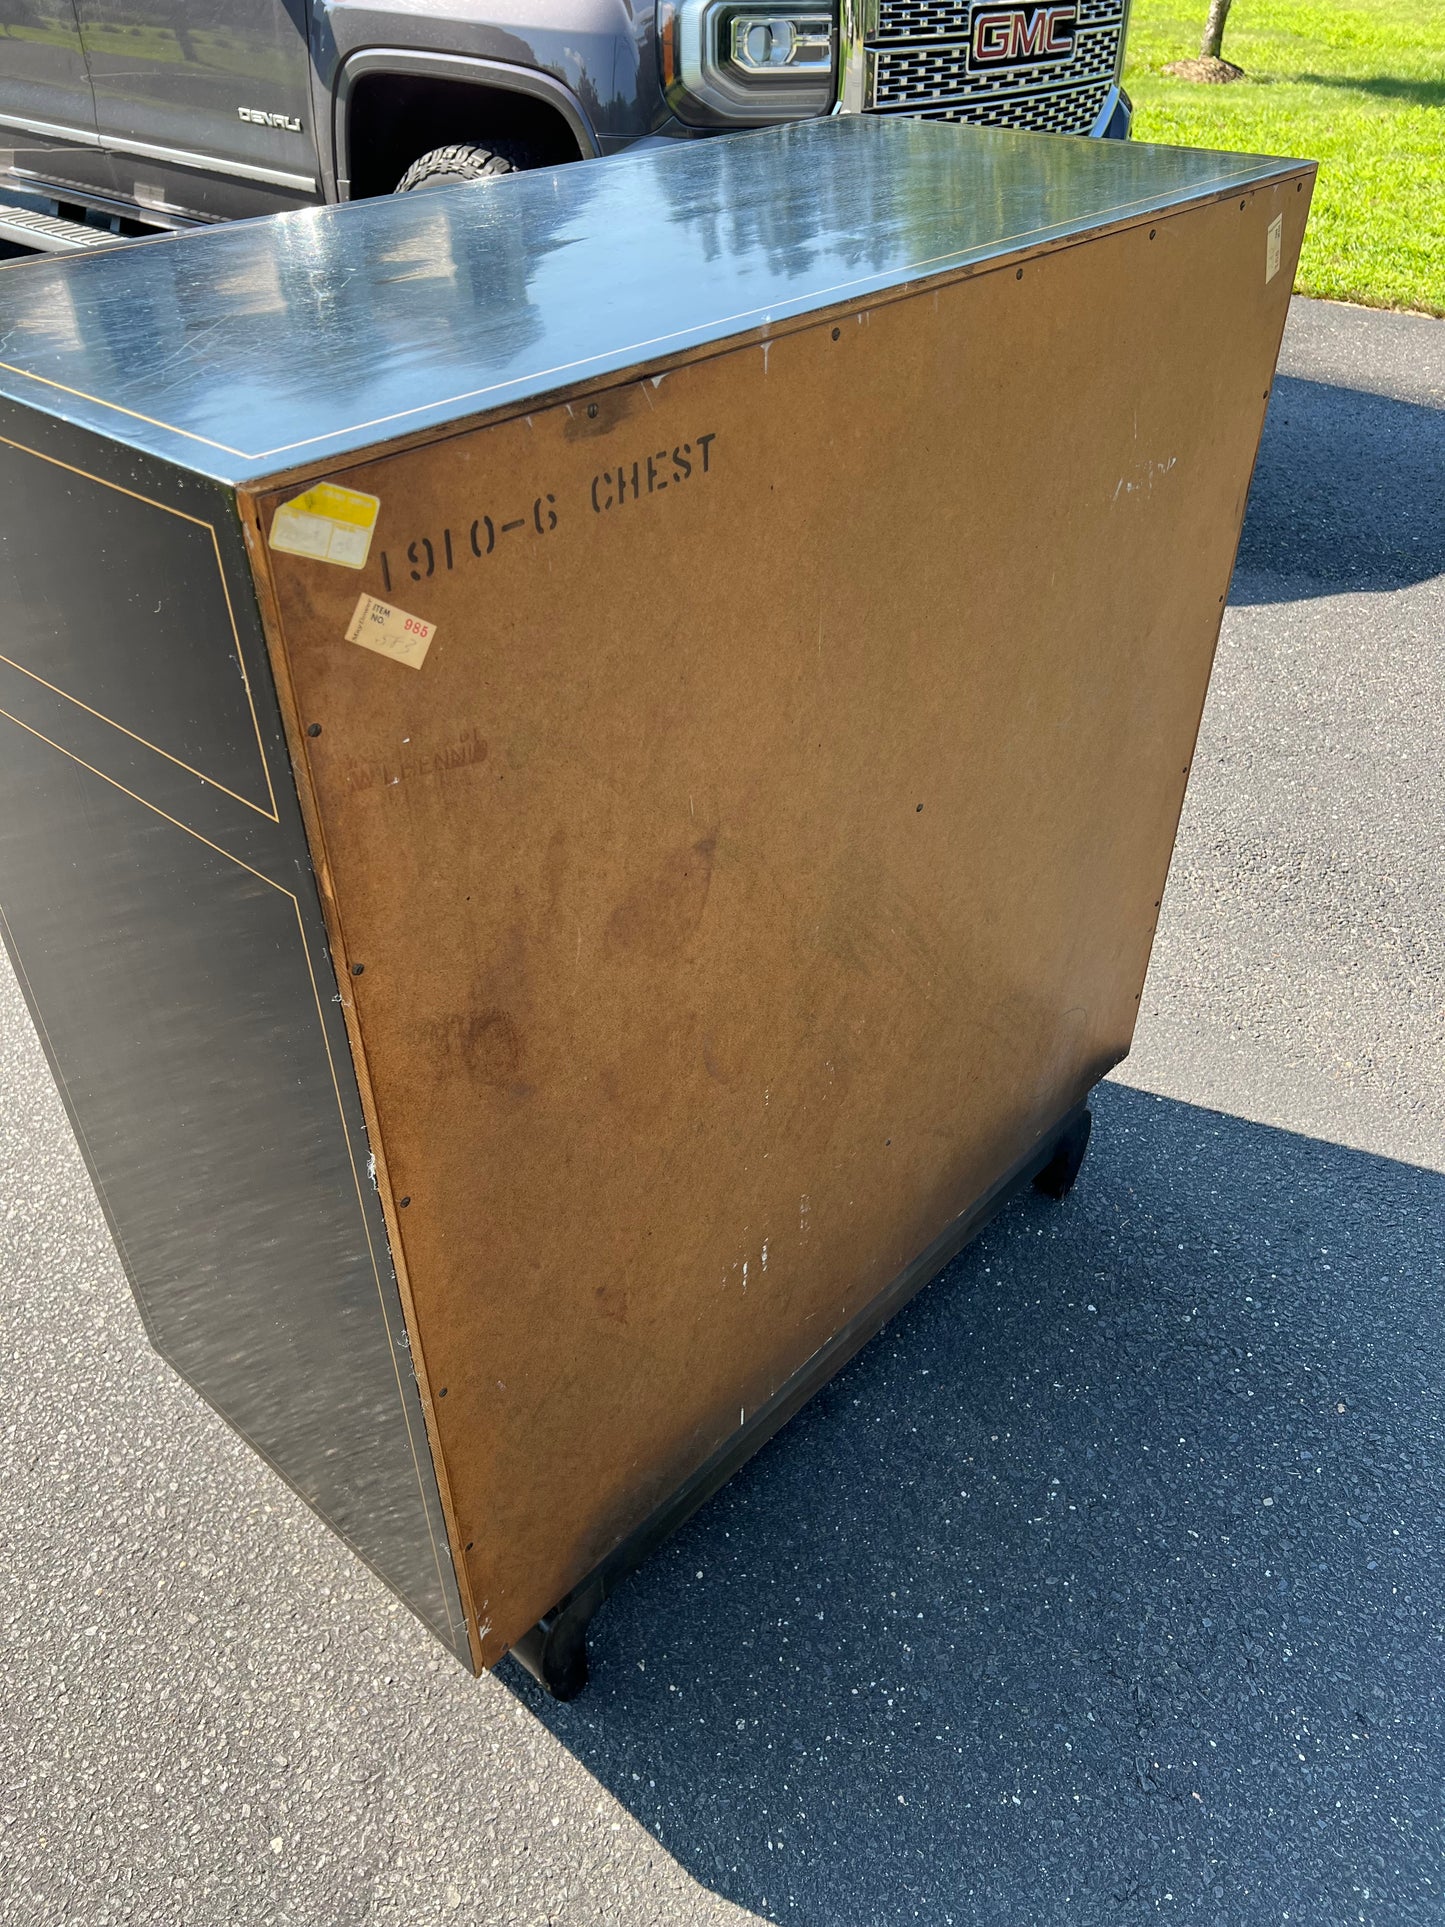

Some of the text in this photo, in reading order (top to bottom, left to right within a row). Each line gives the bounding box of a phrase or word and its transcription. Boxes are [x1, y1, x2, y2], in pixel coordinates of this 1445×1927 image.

[973, 5, 1076, 62] GMC
[237, 107, 303, 133] DENALI
[381, 433, 716, 592] 1910-6 CHEST
[371, 614, 384, 626] NO.
[372, 604, 390, 617] ITEM
[404, 618, 428, 638] 985
